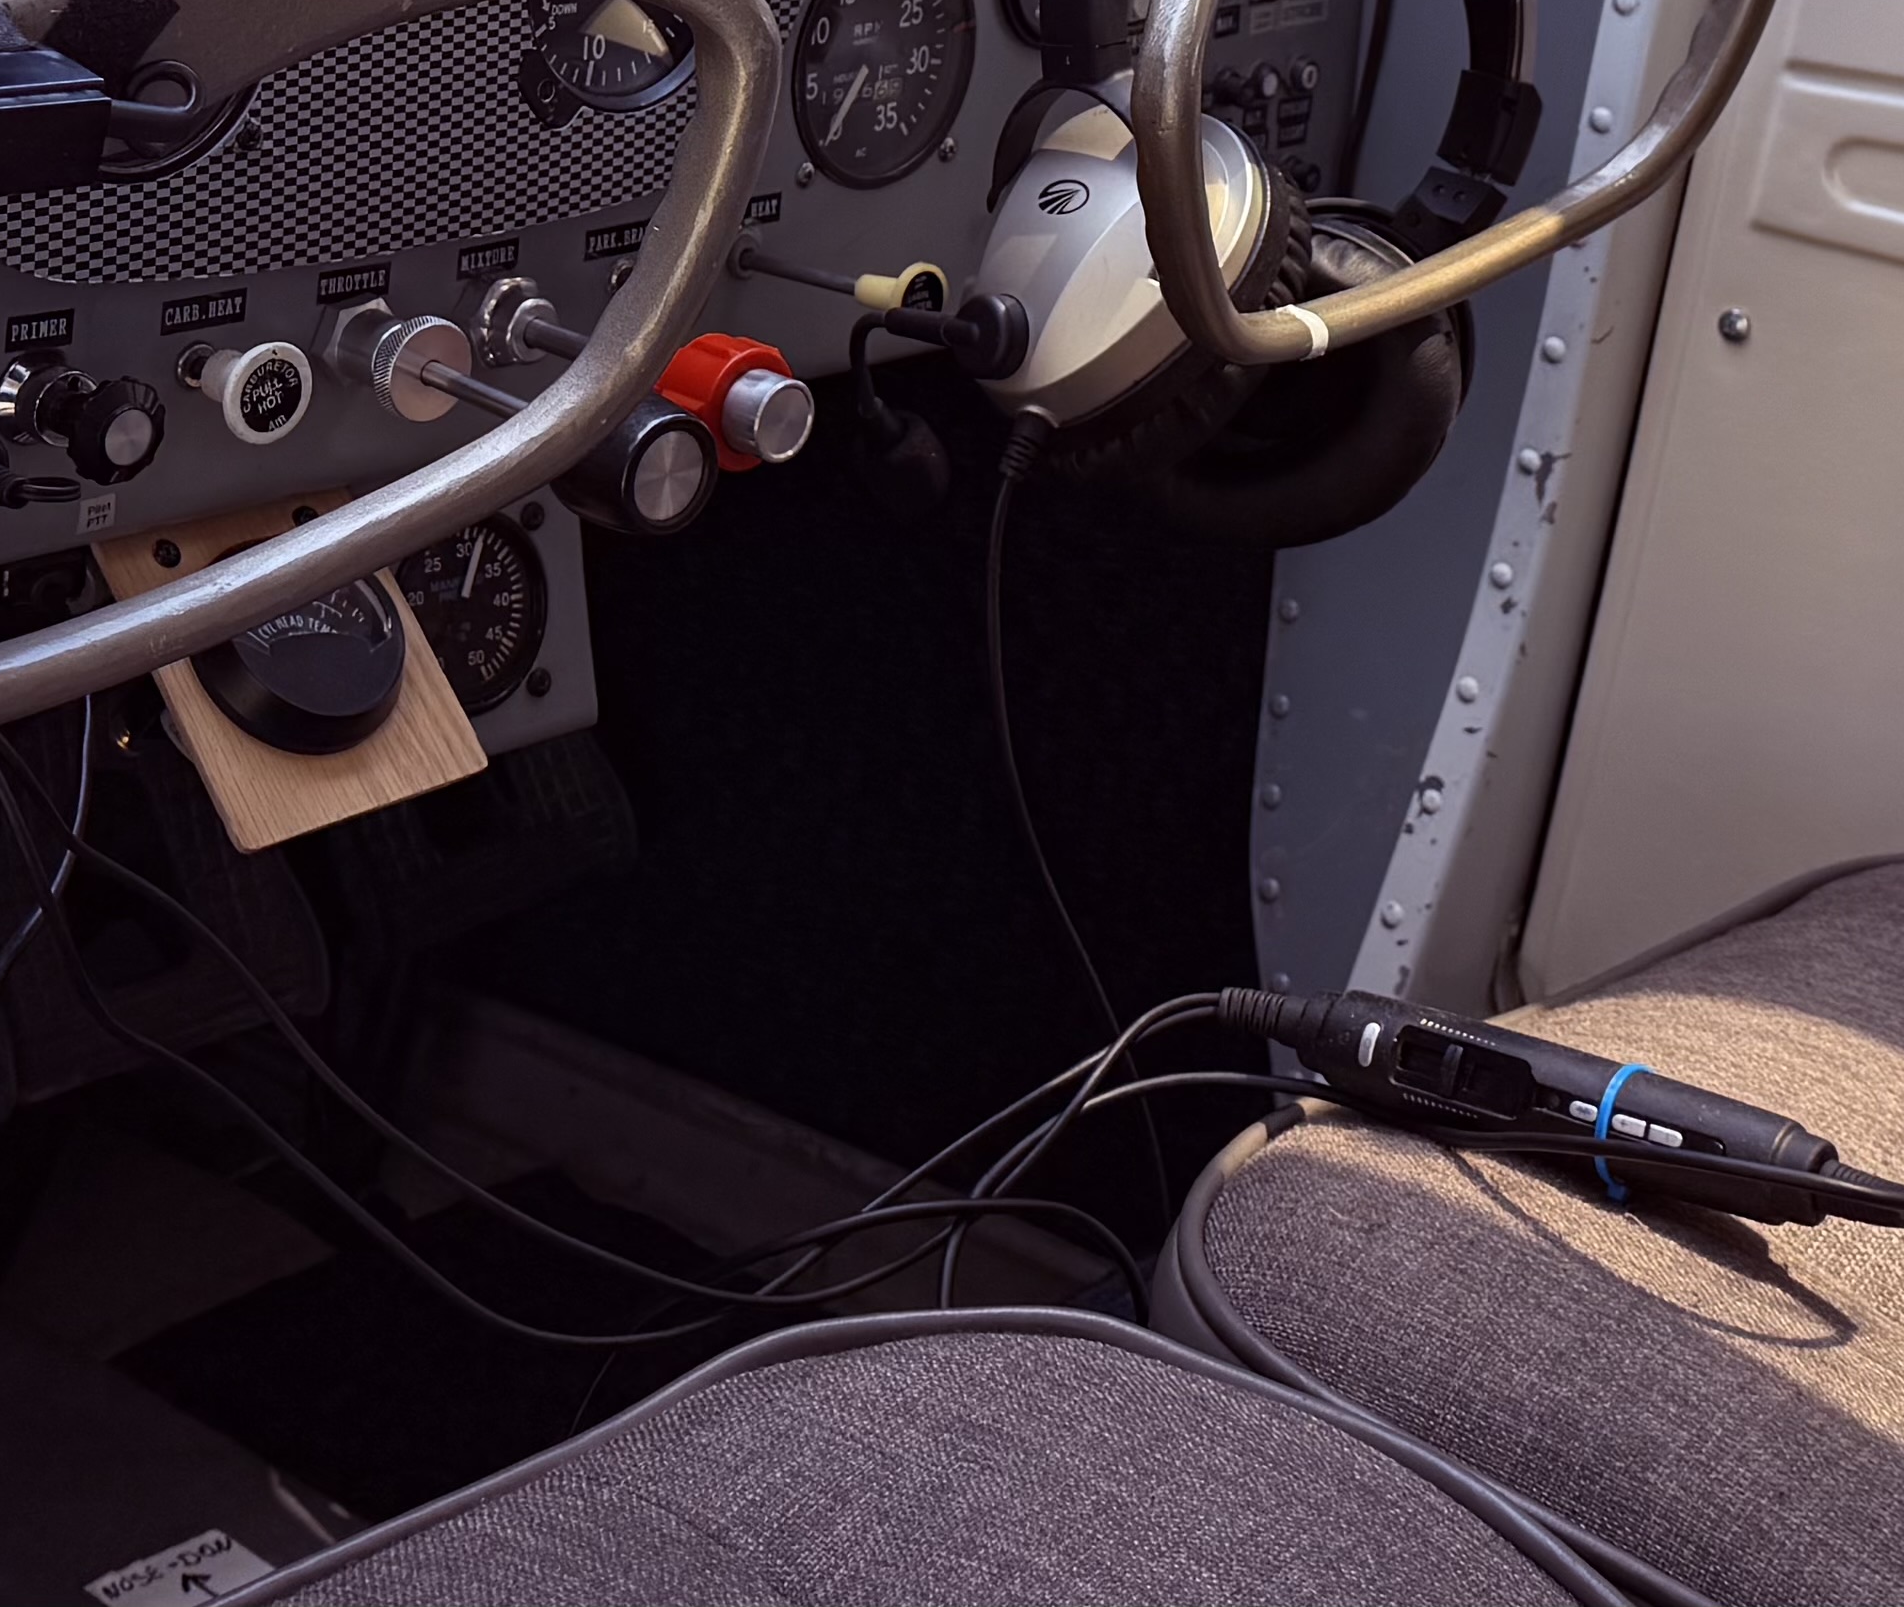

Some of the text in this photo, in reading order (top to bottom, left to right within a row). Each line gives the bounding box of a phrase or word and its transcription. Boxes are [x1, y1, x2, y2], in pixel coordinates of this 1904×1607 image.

[551, 2, 578, 16] DOWN
[583, 33, 606, 60] 10
[906, 44, 930, 75] 30
[874, 101, 898, 132] 35
[460, 245, 517, 272] MIXTURE
[319, 268, 387, 294] THROTTLE
[164, 297, 244, 328] CARB.HEAT
[10, 318, 68, 342] PRIMER
[243, 361, 298, 414] CARBURETOR
[258, 390, 282, 414] HOT
[456, 543, 473, 558] 30
[424, 557, 442, 573] 25
[485, 562, 502, 579] 35
[493, 592, 510, 607] 40
[276, 615, 304, 630] HEAD
[485, 626, 503, 641] 45
[468, 649, 485, 666] 50
